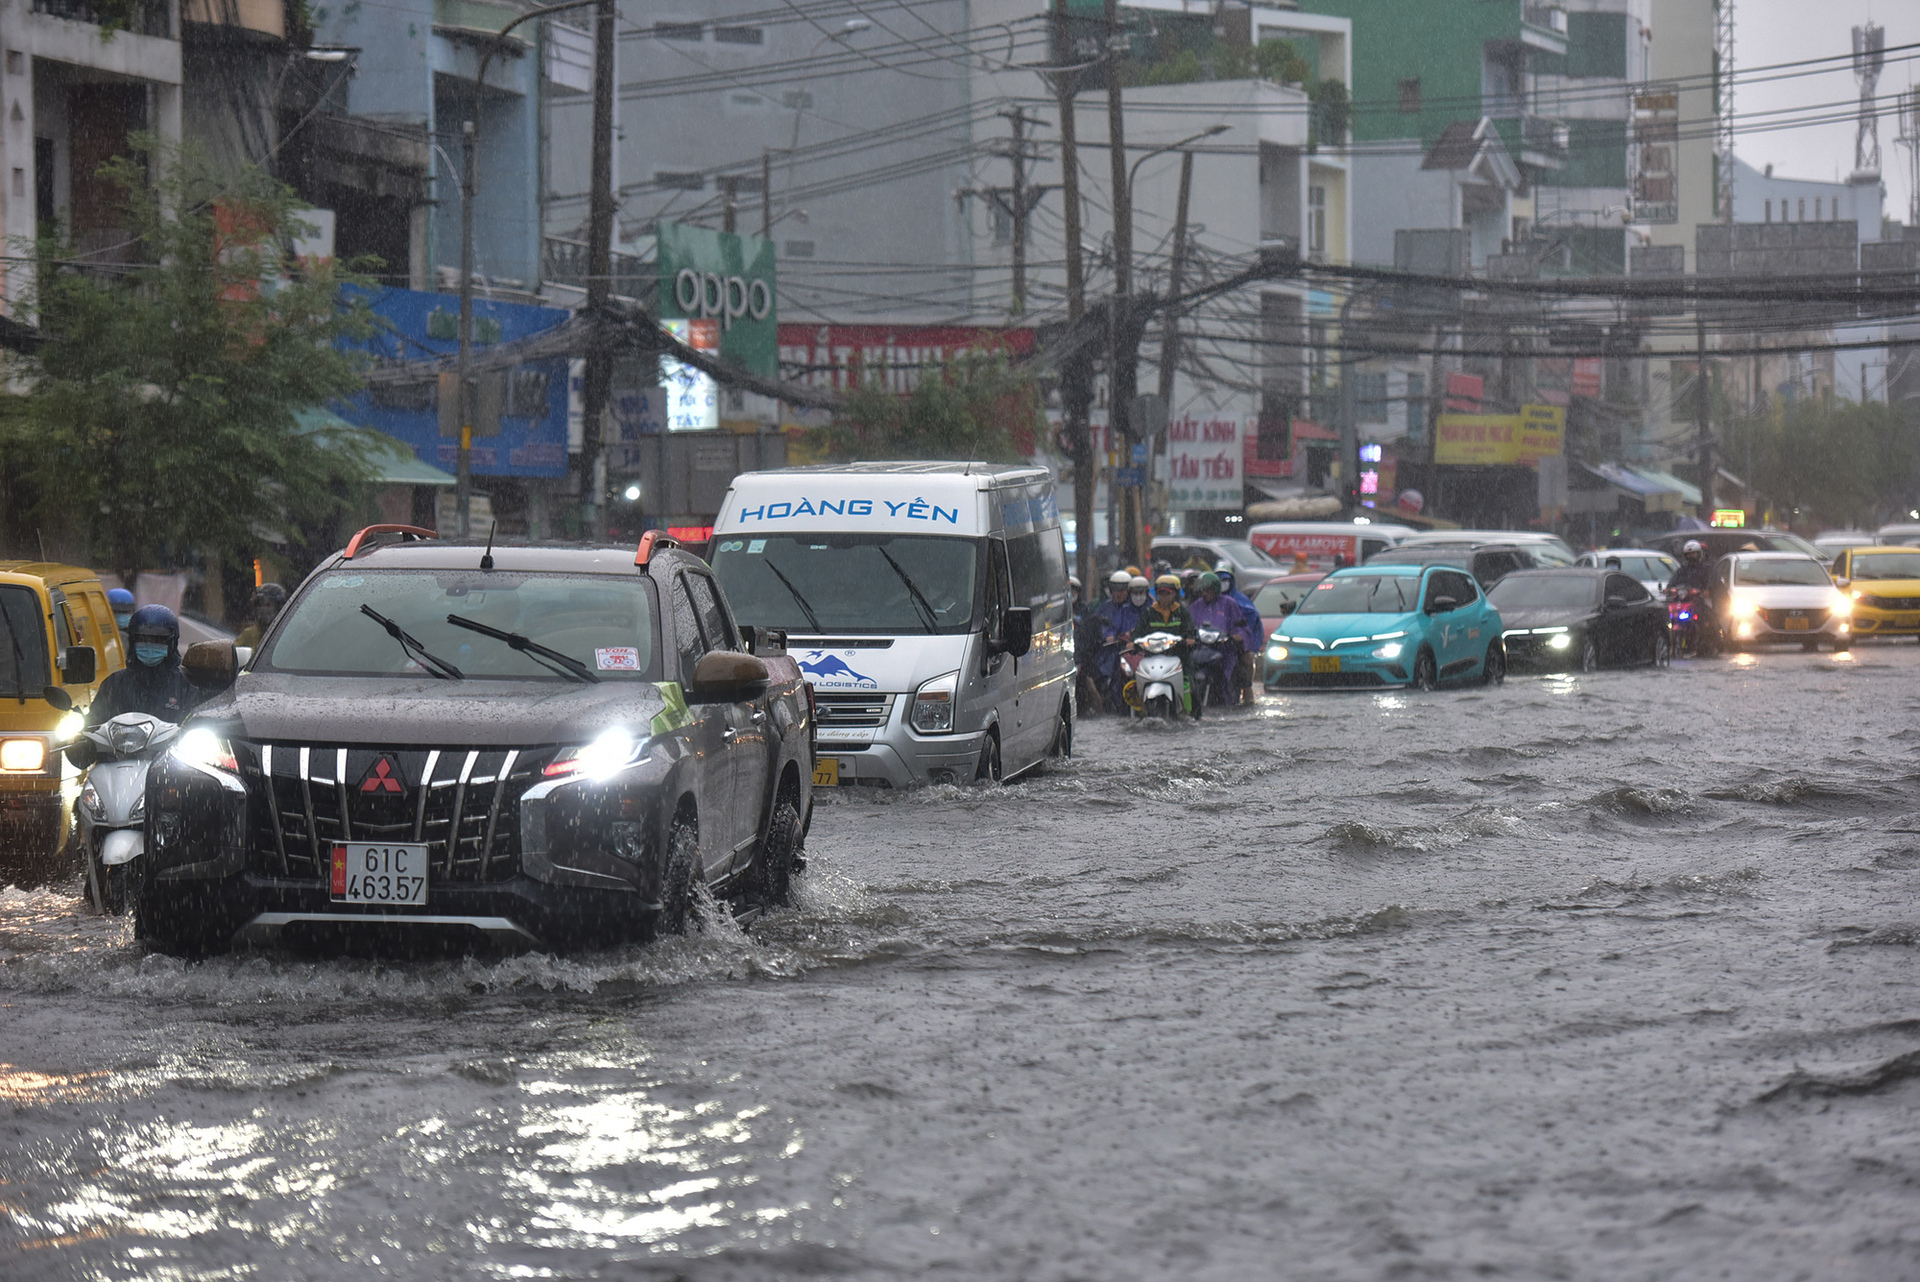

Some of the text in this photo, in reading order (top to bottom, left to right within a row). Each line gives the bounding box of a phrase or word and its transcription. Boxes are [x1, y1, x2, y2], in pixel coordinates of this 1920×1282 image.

[739, 496, 959, 525] HOÀNG YẾN
[1281, 536, 1347, 550] LALAMOVE
[819, 681, 878, 690] LOGISTICS
[365, 847, 408, 873] 61C
[347, 874, 425, 901] 463.57
